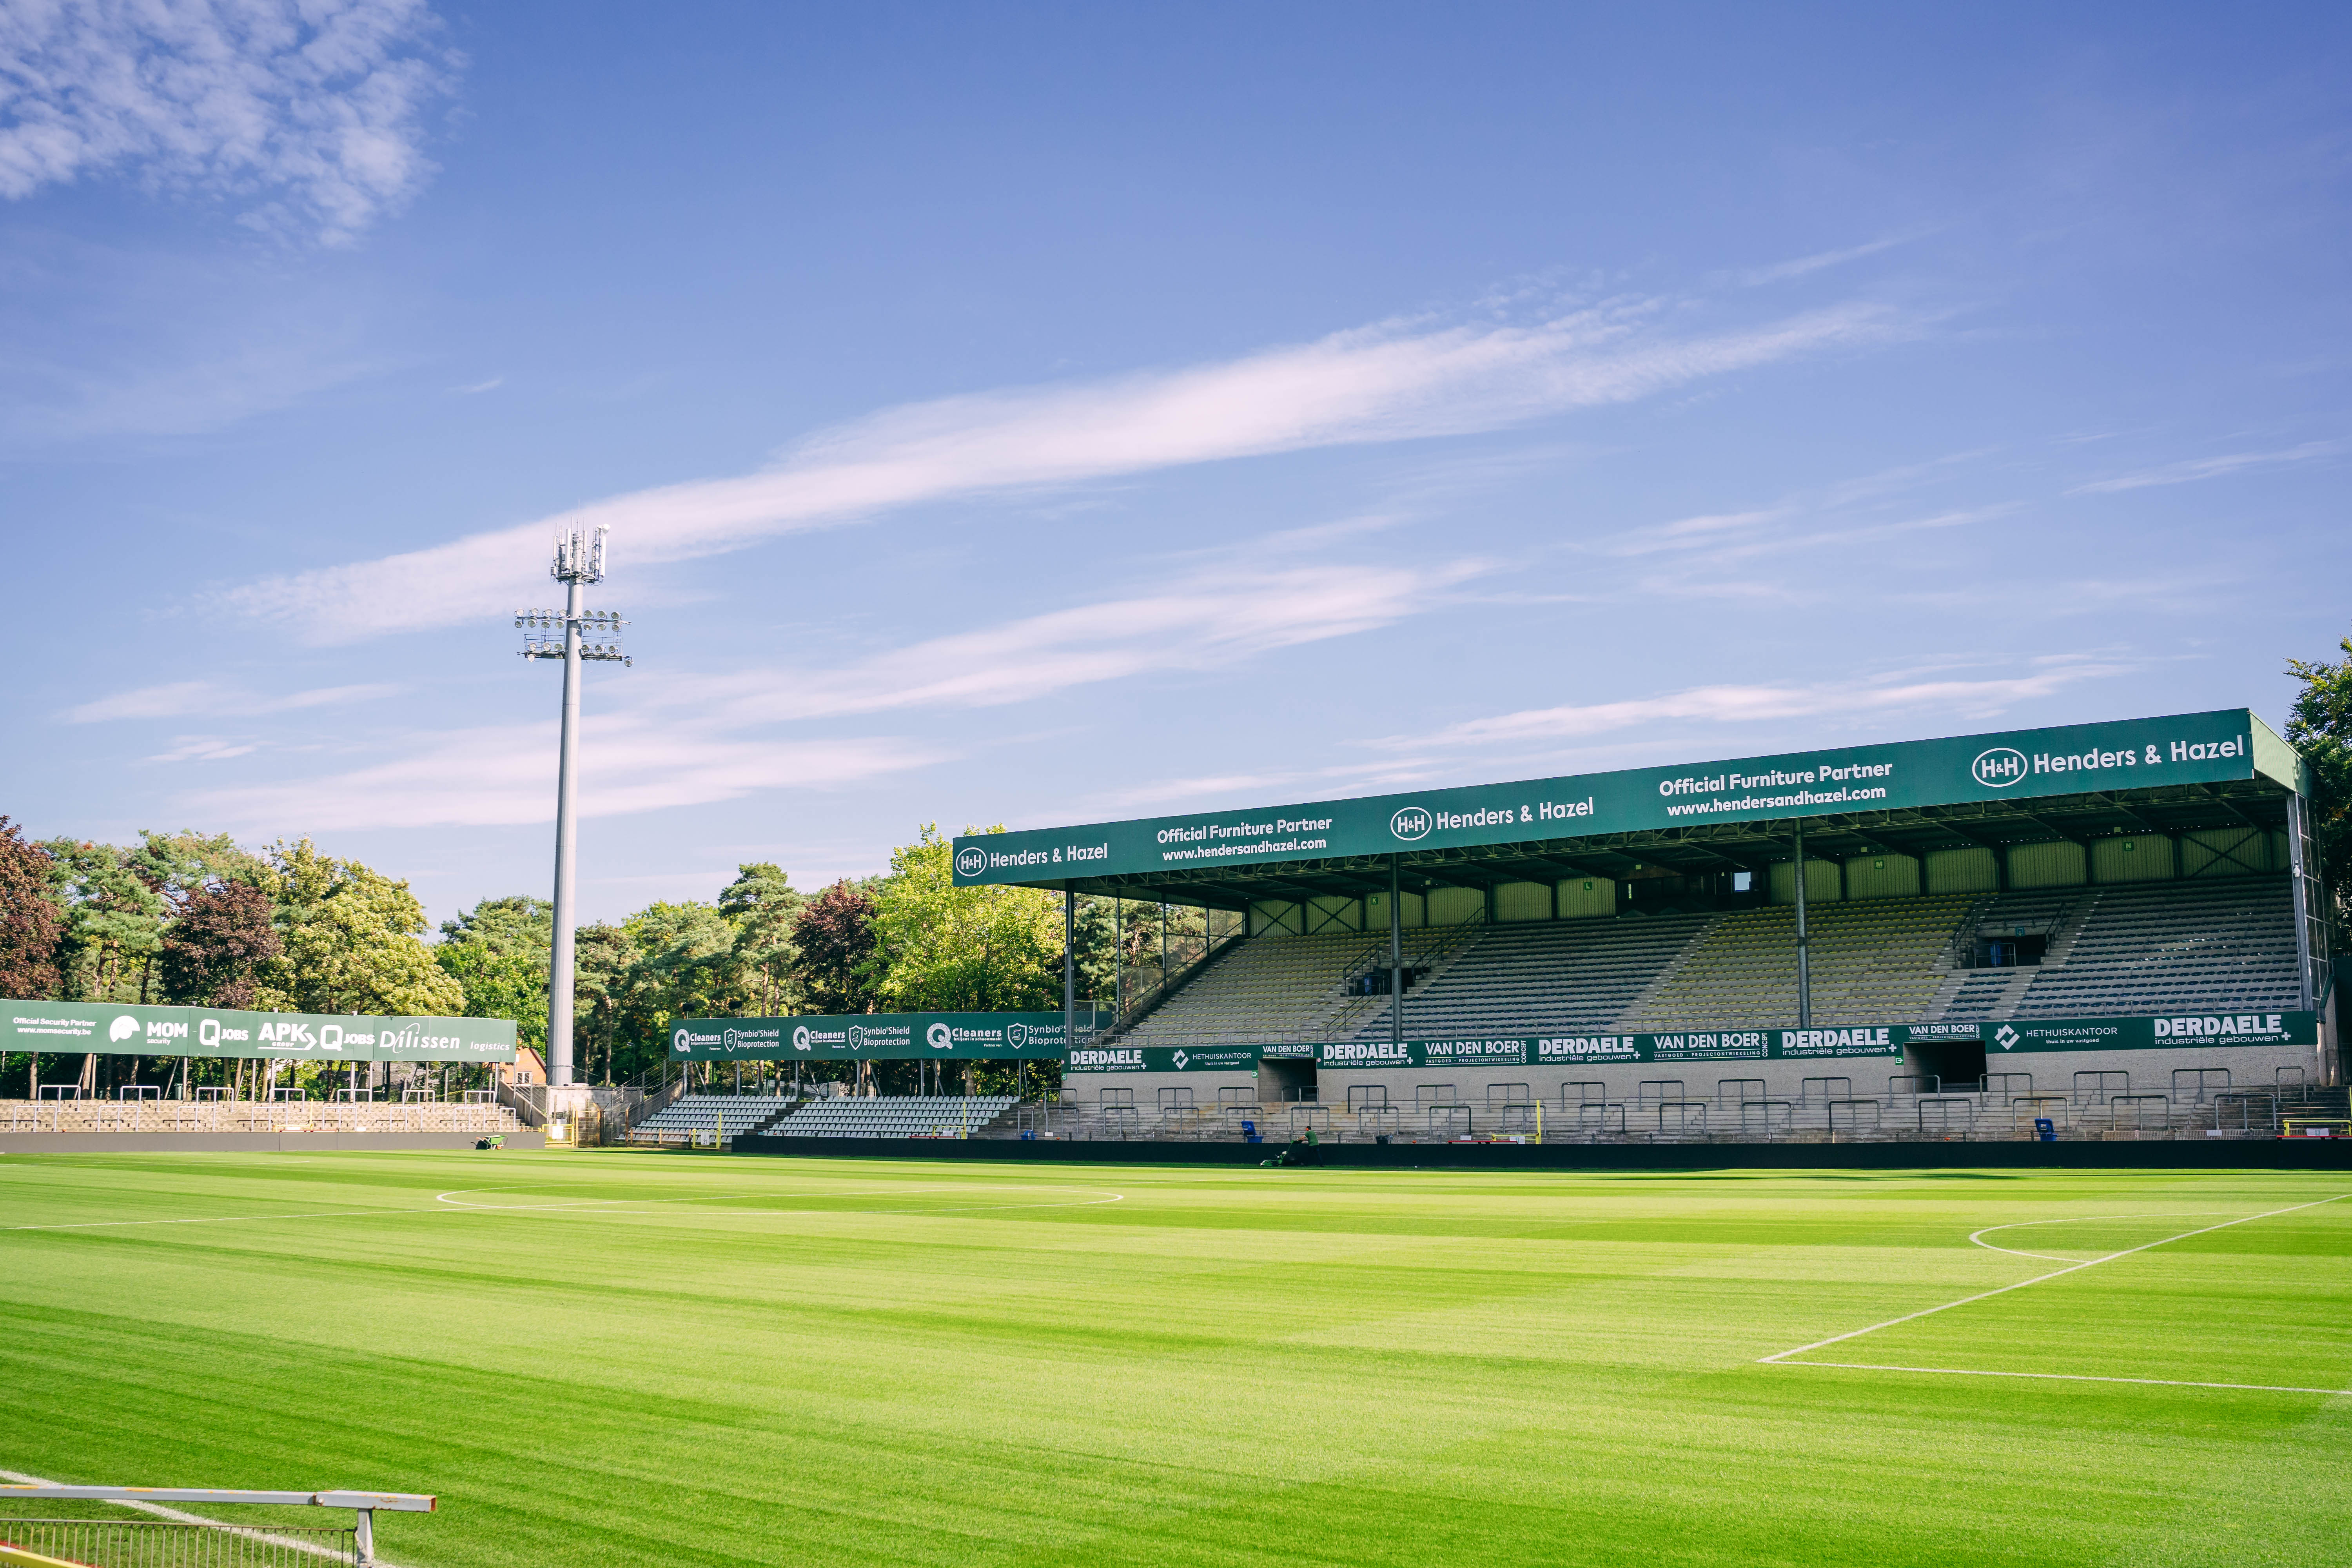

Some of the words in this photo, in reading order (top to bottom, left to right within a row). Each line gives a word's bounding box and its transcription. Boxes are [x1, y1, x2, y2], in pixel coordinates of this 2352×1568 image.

[1982, 757, 2018, 778] H&H
[2034, 748, 2136, 774] Henders
[2145, 744, 2162, 764] &
[2171, 735, 2243, 762] Hazel
[1659, 775, 1724, 796] Official
[1729, 770, 1815, 789] Furniture
[1819, 763, 1892, 782] Partner
[1667, 786, 1886, 816] www.hendersandhazel.com
[1397, 815, 1425, 833] H&H
[1437, 808, 1513, 829] Henders
[1520, 805, 1533, 822] &
[1540, 797, 1593, 820] Hazel
[1157, 826, 1207, 844] Official
[1210, 822, 1274, 838] Furniture
[1277, 817, 1332, 833] Partner
[961, 854, 981, 870] H&H
[991, 849, 1048, 868] Henders
[1052, 848, 1063, 862] &
[1067, 843, 1107, 861] Hazel
[1163, 838, 1327, 860] www.hendersandhazel.com
[40, 1018, 69, 1027] Security
[147, 1022, 188, 1037] MOM
[1909, 1026, 1928, 1034] VAN
[1931, 1025, 1949, 1033] DEN
[1951, 1024, 1975, 1033] BOER
[2154, 1014, 2282, 1036] DERDAELE
[18, 1027, 91, 1036] www.momsecurity.be
[221, 1029, 249, 1040] JOBS
[258, 1022, 309, 1042] APK
[343, 1033, 375, 1045] JOBS
[379, 1023, 460, 1053] Dilissen
[810, 1031, 845, 1039] Cleaners
[952, 1028, 1002, 1037] Cleaners
[1782, 1028, 1889, 1048] DERDAELE
[2026, 1027, 2117, 1037] HETHUISKANTOOR
[470, 1042, 510, 1052] logistics
[737, 1040, 779, 1049] Bioprotection
[864, 1037, 910, 1047] Bioprotection
[1425, 1042, 1452, 1055] VAN
[1456, 1041, 1481, 1054] DEN
[1486, 1040, 1519, 1053] BOER
[1539, 1036, 1634, 1054] DERDAELE
[1653, 1035, 1684, 1049] VAN
[1688, 1034, 1717, 1048] DEN
[1722, 1033, 1760, 1047] BOER
[2155, 1036, 2215, 1045] industriële
[2219, 1035, 2278, 1044] gebouwen
[1071, 1050, 1142, 1064] DERDAELE
[1323, 1043, 1407, 1059] DERDAELE
